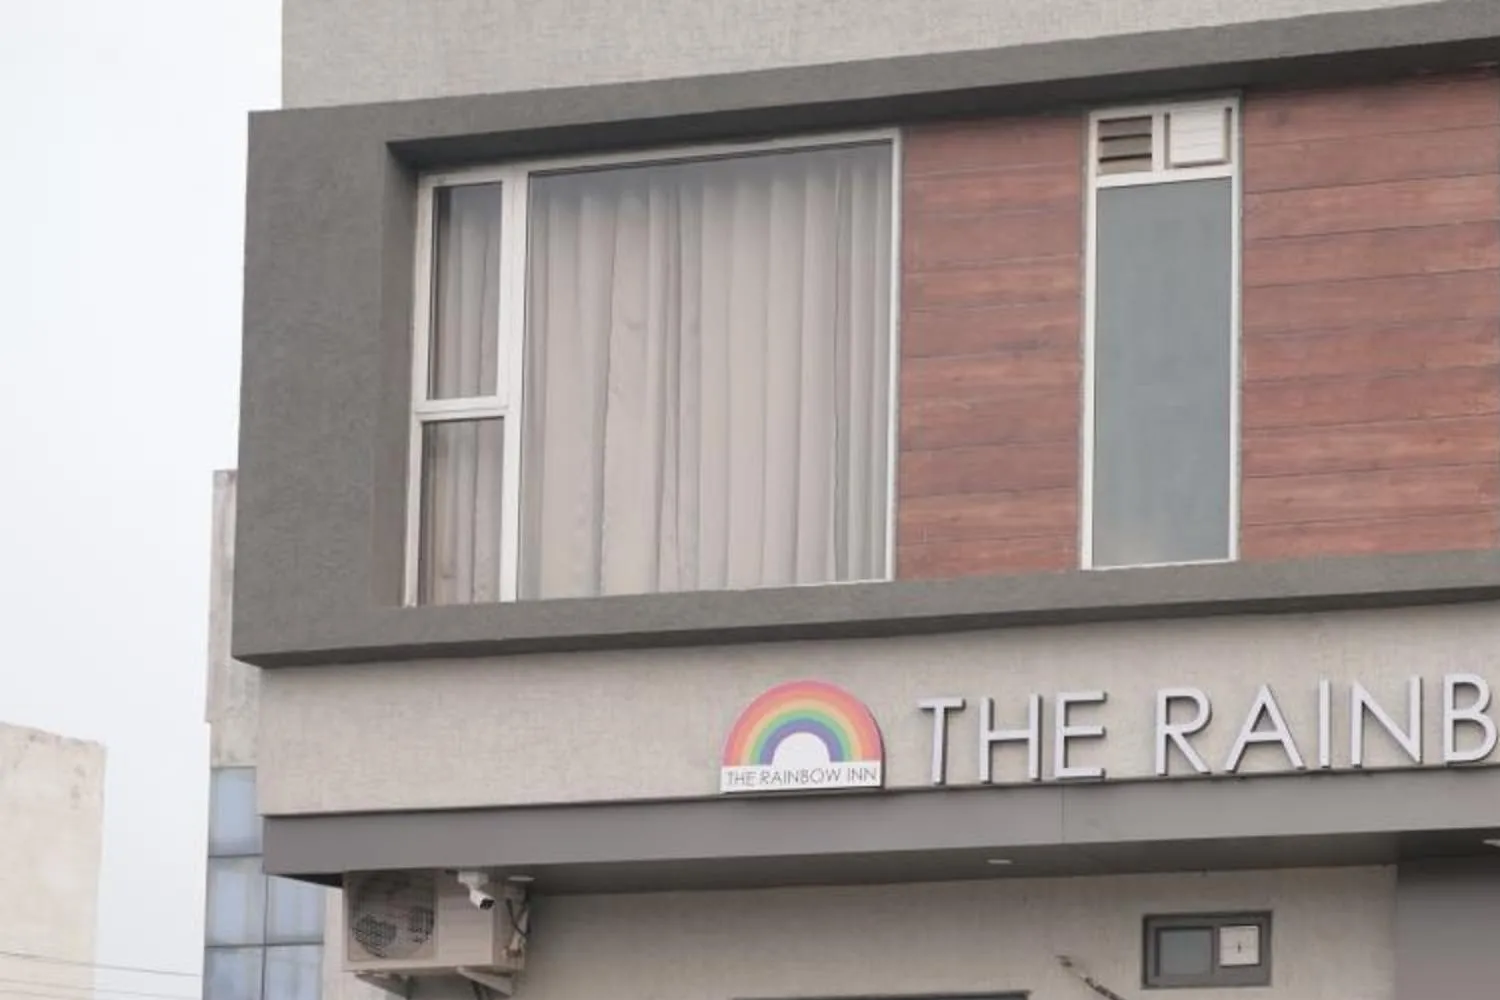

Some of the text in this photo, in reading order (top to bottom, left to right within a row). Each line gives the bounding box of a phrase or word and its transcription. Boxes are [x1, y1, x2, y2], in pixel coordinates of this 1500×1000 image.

[917, 691, 1108, 785] THE
[726, 767, 877, 787] THE RAINBOW INN
